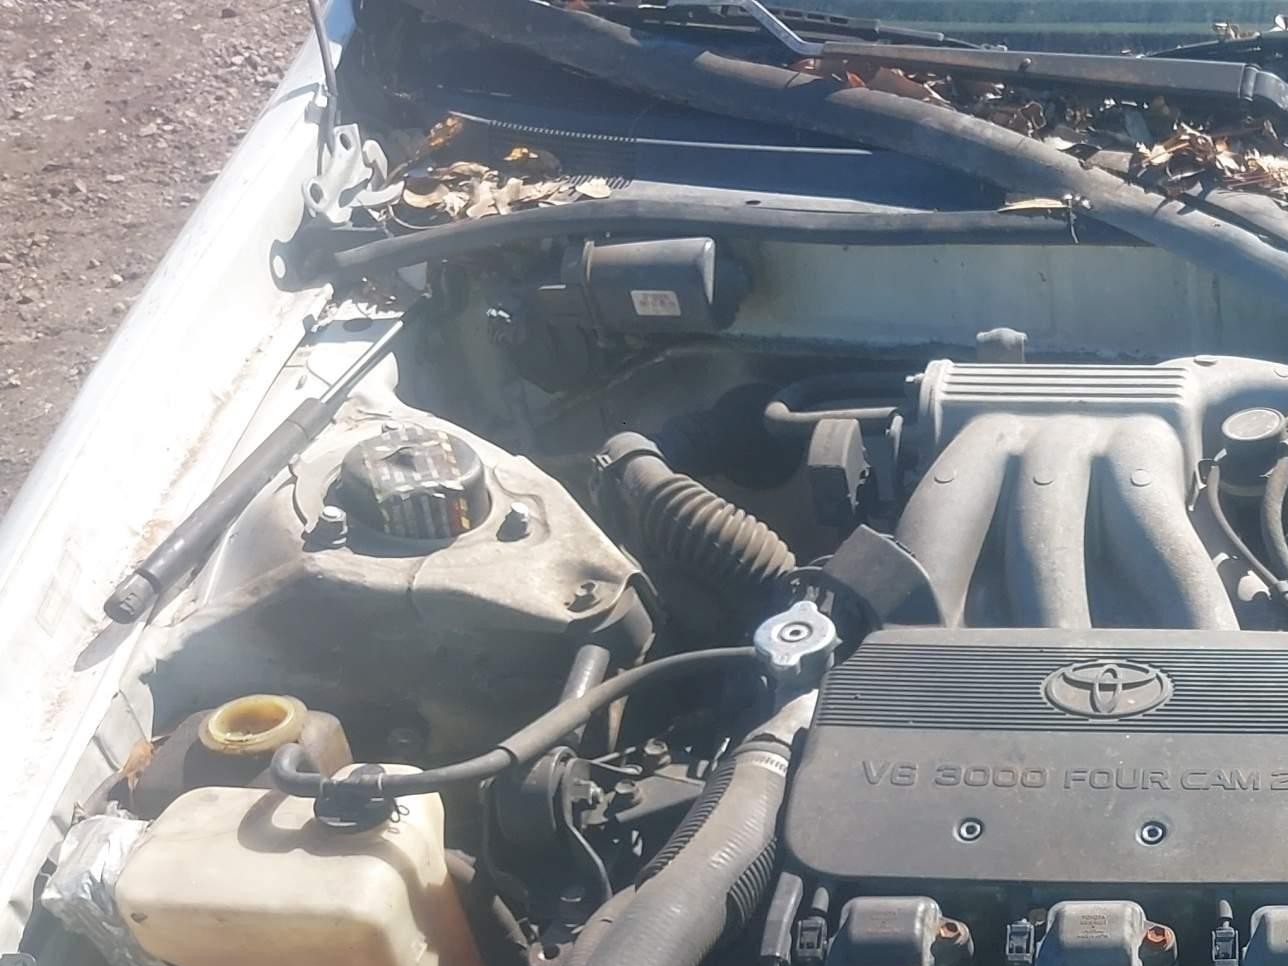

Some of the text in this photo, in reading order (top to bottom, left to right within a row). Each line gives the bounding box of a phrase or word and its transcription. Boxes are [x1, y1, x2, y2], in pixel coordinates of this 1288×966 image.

[861, 759, 918, 786] V6
[934, 764, 1048, 789] 3000
[1064, 766, 1170, 791] FOUR
[1180, 768, 1260, 791] CAM
